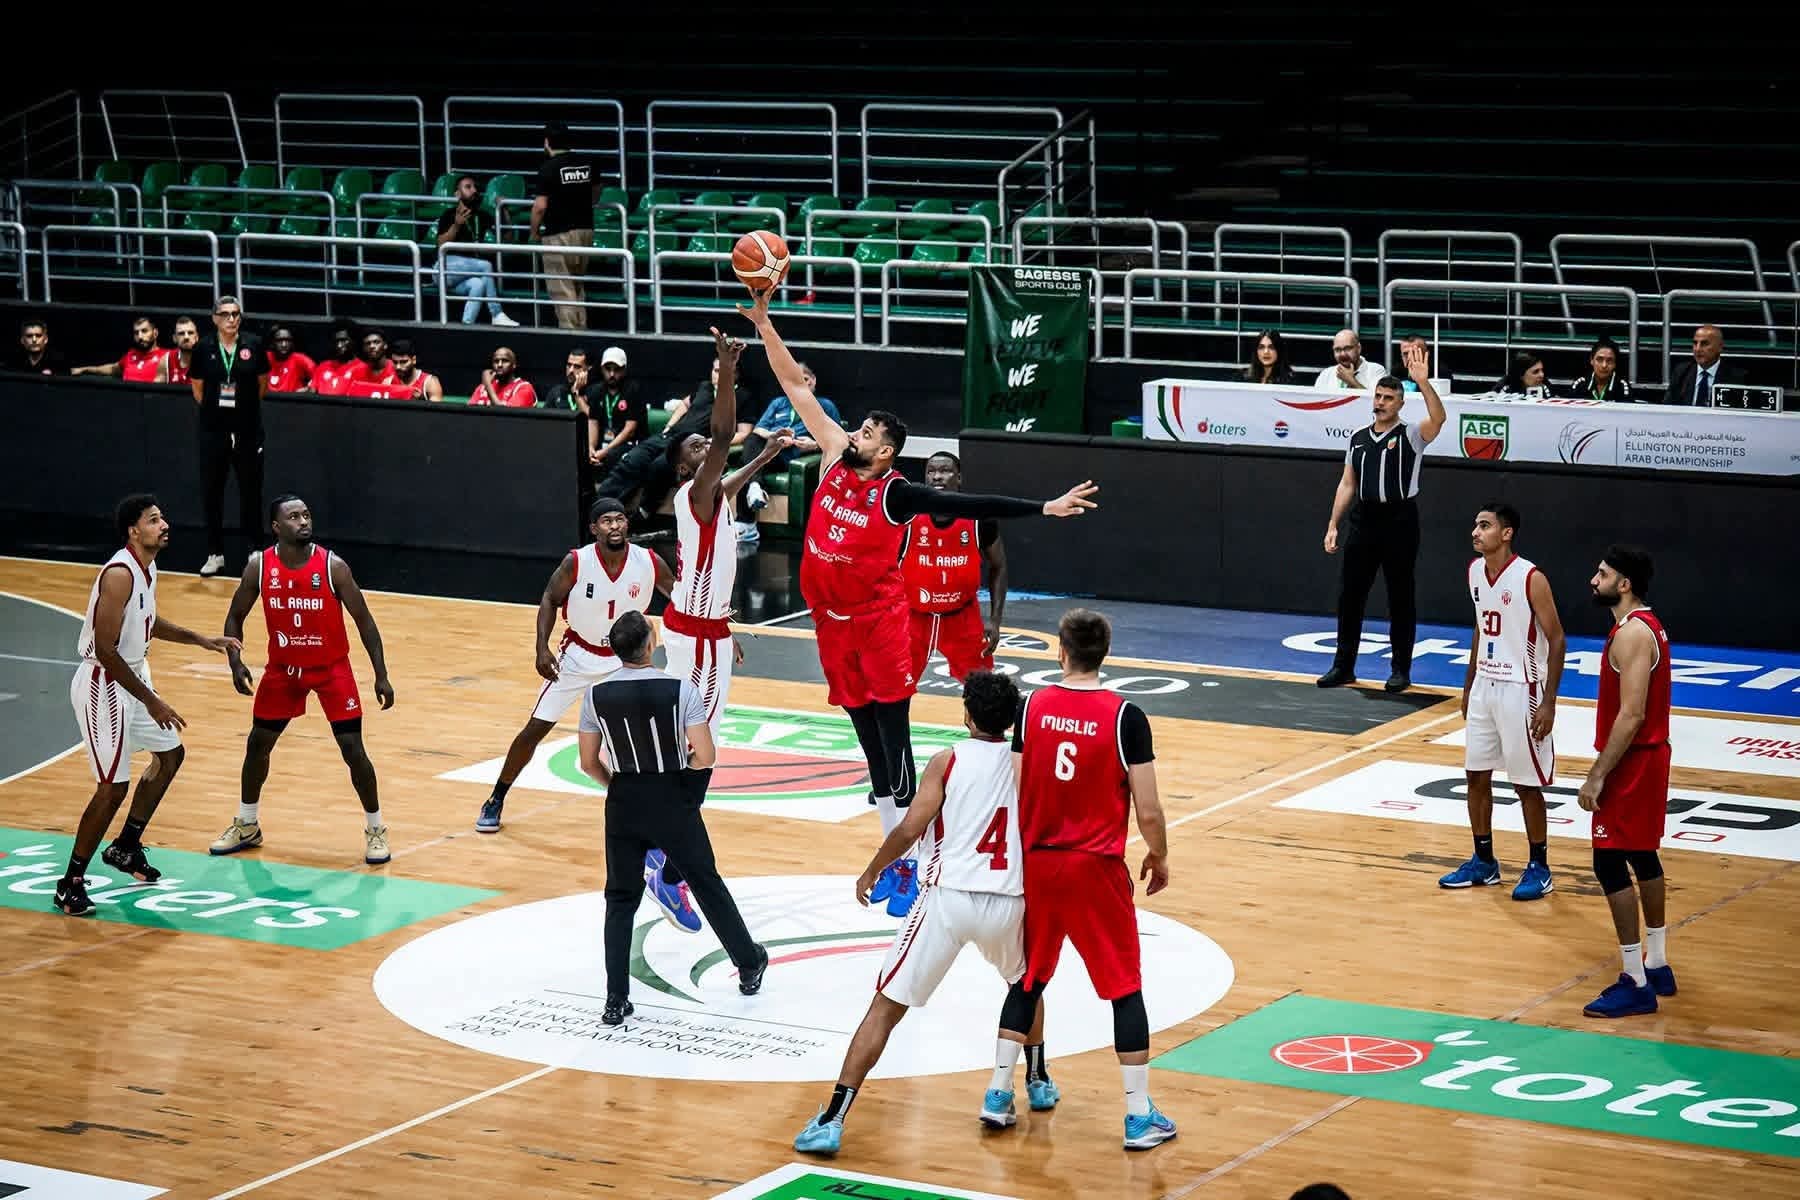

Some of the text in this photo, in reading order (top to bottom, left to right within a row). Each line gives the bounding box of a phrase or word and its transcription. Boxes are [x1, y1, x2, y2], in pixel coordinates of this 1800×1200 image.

[564, 170, 589, 181] mtv
[1014, 269, 1081, 281] SAGESSE
[1015, 280, 1082, 291] SPORTS CLUB
[1010, 314, 1043, 339] WE
[1007, 363, 1039, 388] WE
[1209, 423, 1247, 436] toters
[1465, 421, 1505, 436] ABC
[1625, 441, 1746, 457] ELLINGTON PROPERTIES
[1624, 453, 1733, 468] ARAB CHAMPIONSHIP
[821, 495, 869, 528] AL ARABI
[919, 554, 969, 567] AL ARABI
[941, 570, 947, 585] 1
[269, 597, 324, 611] AL ARABI
[607, 600, 616, 620] 1
[293, 613, 302, 628] 0
[1482, 611, 1502, 637] 30
[1041, 715, 1099, 736] MUSLIC
[1726, 737, 1800, 750] DRIV
[1055, 741, 1078, 781] 6
[975, 807, 1009, 870] 4
[444, 1022, 510, 1037] 2026
[464, 1014, 753, 1060] ARAB CHAMPIONSHIP
[489, 1005, 639, 1033] ELLINGTON
[640, 1028, 808, 1057] PROPERTIES
[1420, 1055, 1800, 1137] tote
